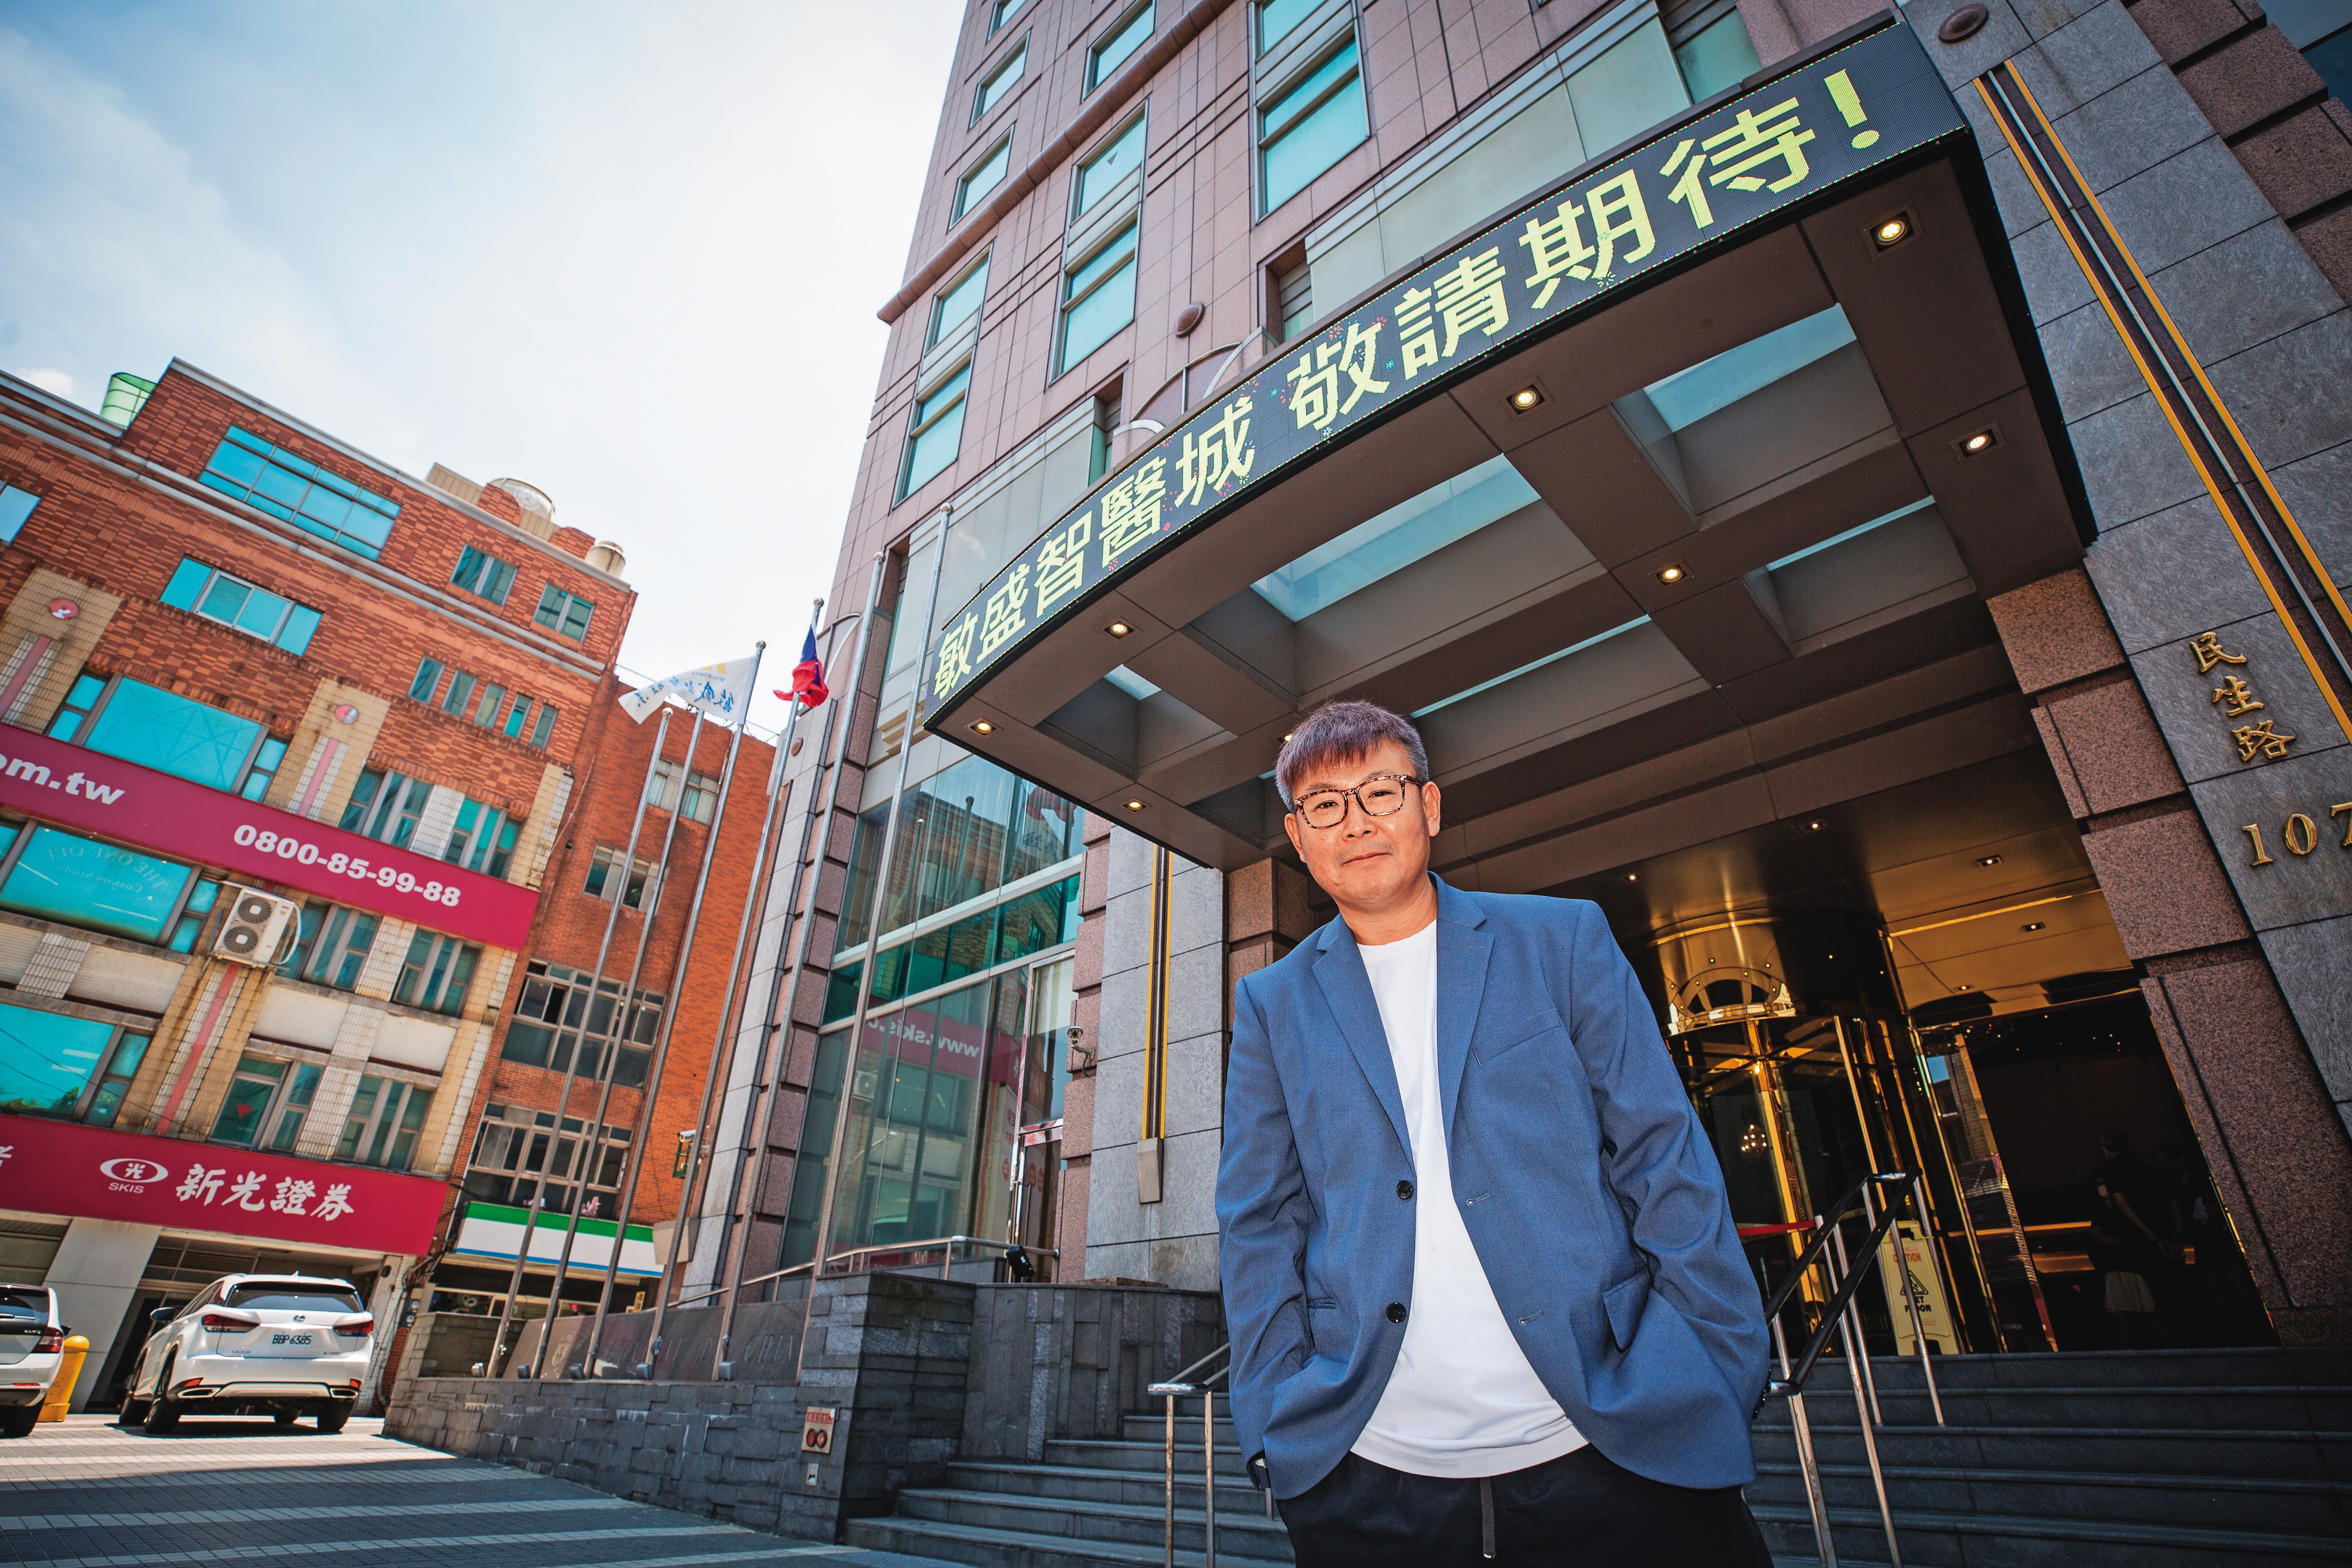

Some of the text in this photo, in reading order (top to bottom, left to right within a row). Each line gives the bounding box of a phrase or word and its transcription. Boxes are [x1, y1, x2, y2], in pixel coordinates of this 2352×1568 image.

[933, 69, 1880, 699] 敏盛智醫城 敬請期待！
[2190, 631, 2296, 762] 民生路
[2242, 802, 2352, 866] 107
[233, 823, 461, 907] 0800-85-99-88
[108, 1182, 145, 1194] SKIS
[176, 1163, 354, 1221] 新光證券
[1893, 1252, 1922, 1263] CTION
[1904, 1304, 1932, 1312] FOR
